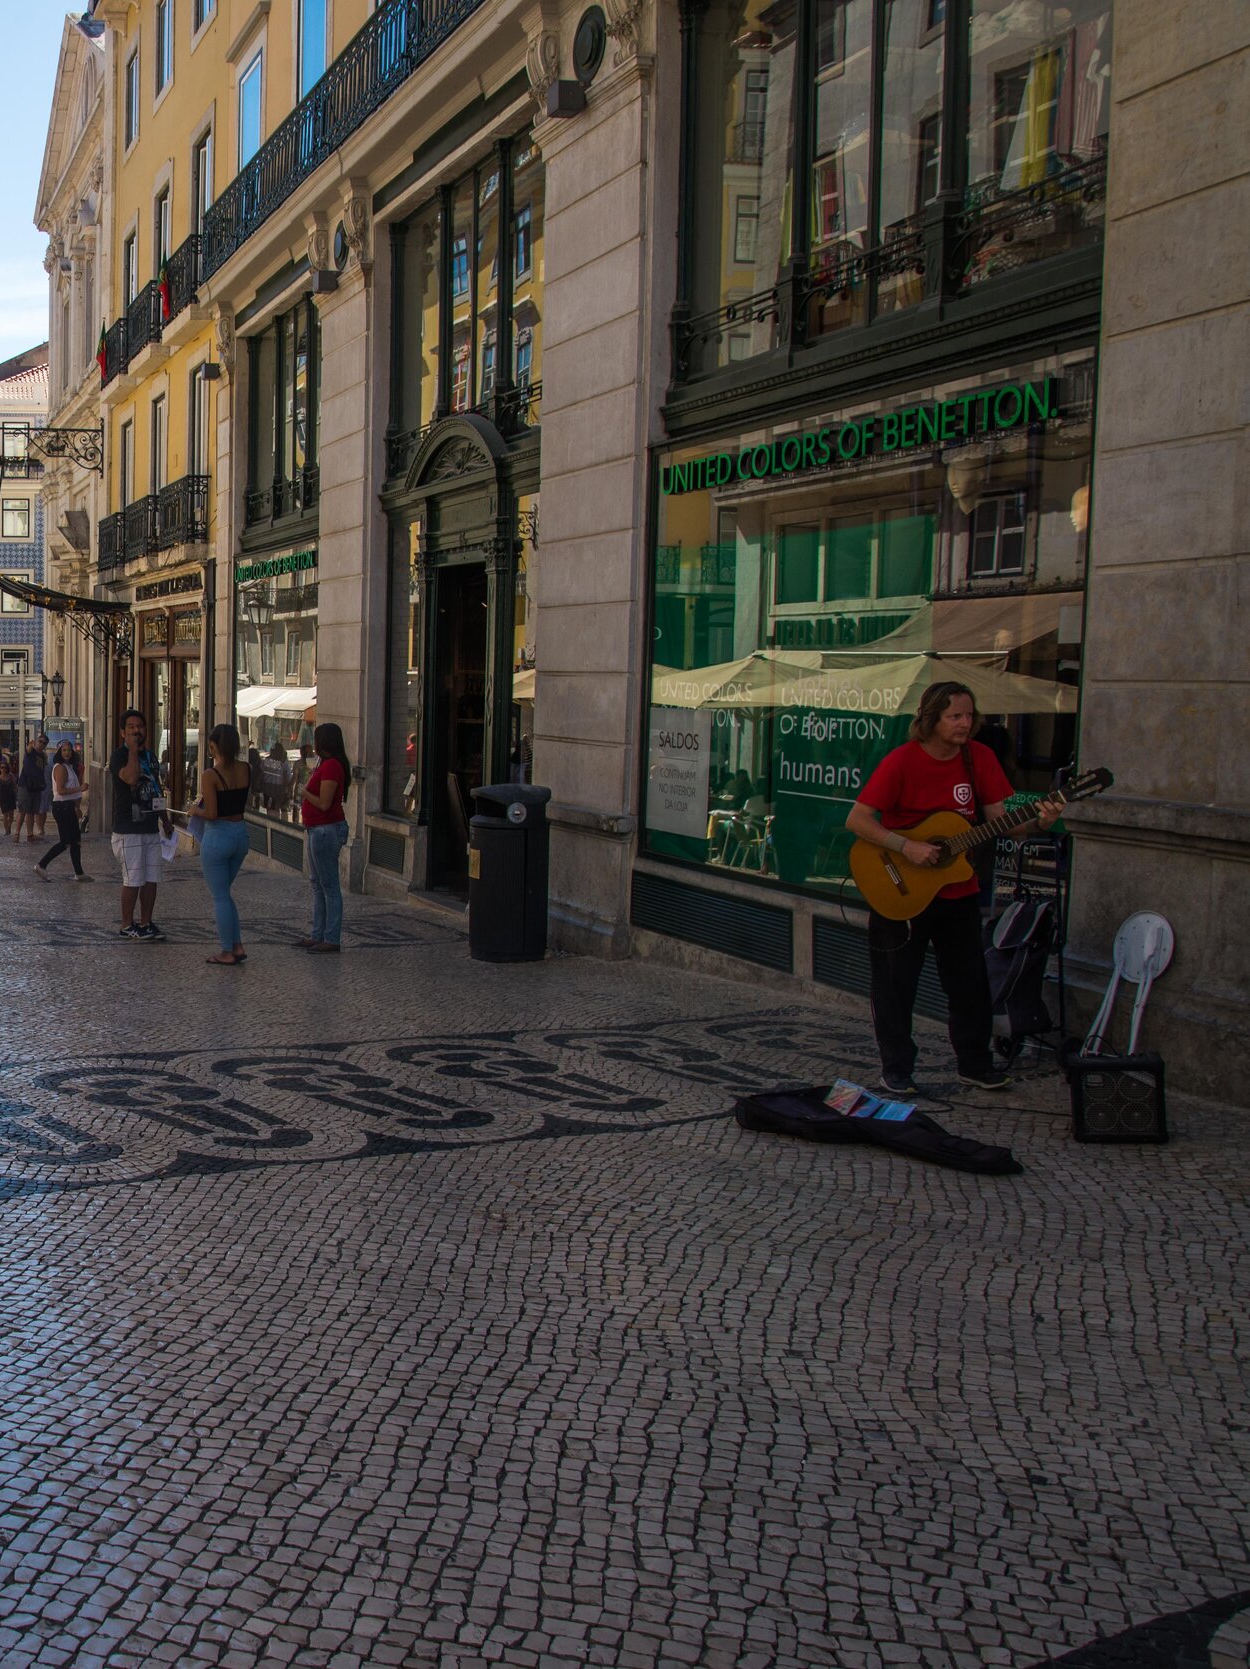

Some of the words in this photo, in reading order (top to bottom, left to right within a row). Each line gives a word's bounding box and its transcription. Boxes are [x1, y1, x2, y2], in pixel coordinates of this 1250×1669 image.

[662, 455, 731, 495] UNITED
[738, 434, 829, 477] COLORS
[838, 421, 874, 459] OF
[882, 375, 1058, 451] BENETTON.
[234, 566, 252, 583] UNITED
[253, 560, 274, 579] COLORS
[274, 559, 282, 575] OF
[660, 679, 700, 701] UNITED
[702, 682, 752, 702] COLORS
[781, 688, 833, 710] UNITED
[837, 687, 901, 711] COLORS
[659, 731, 699, 751] SALDOS
[660, 768, 696, 781] CONTINUAM
[780, 751, 861, 789] humans
[658, 784, 668, 794] NO
[670, 784, 696, 798] INTERIOR
[664, 798, 672, 808] DA
